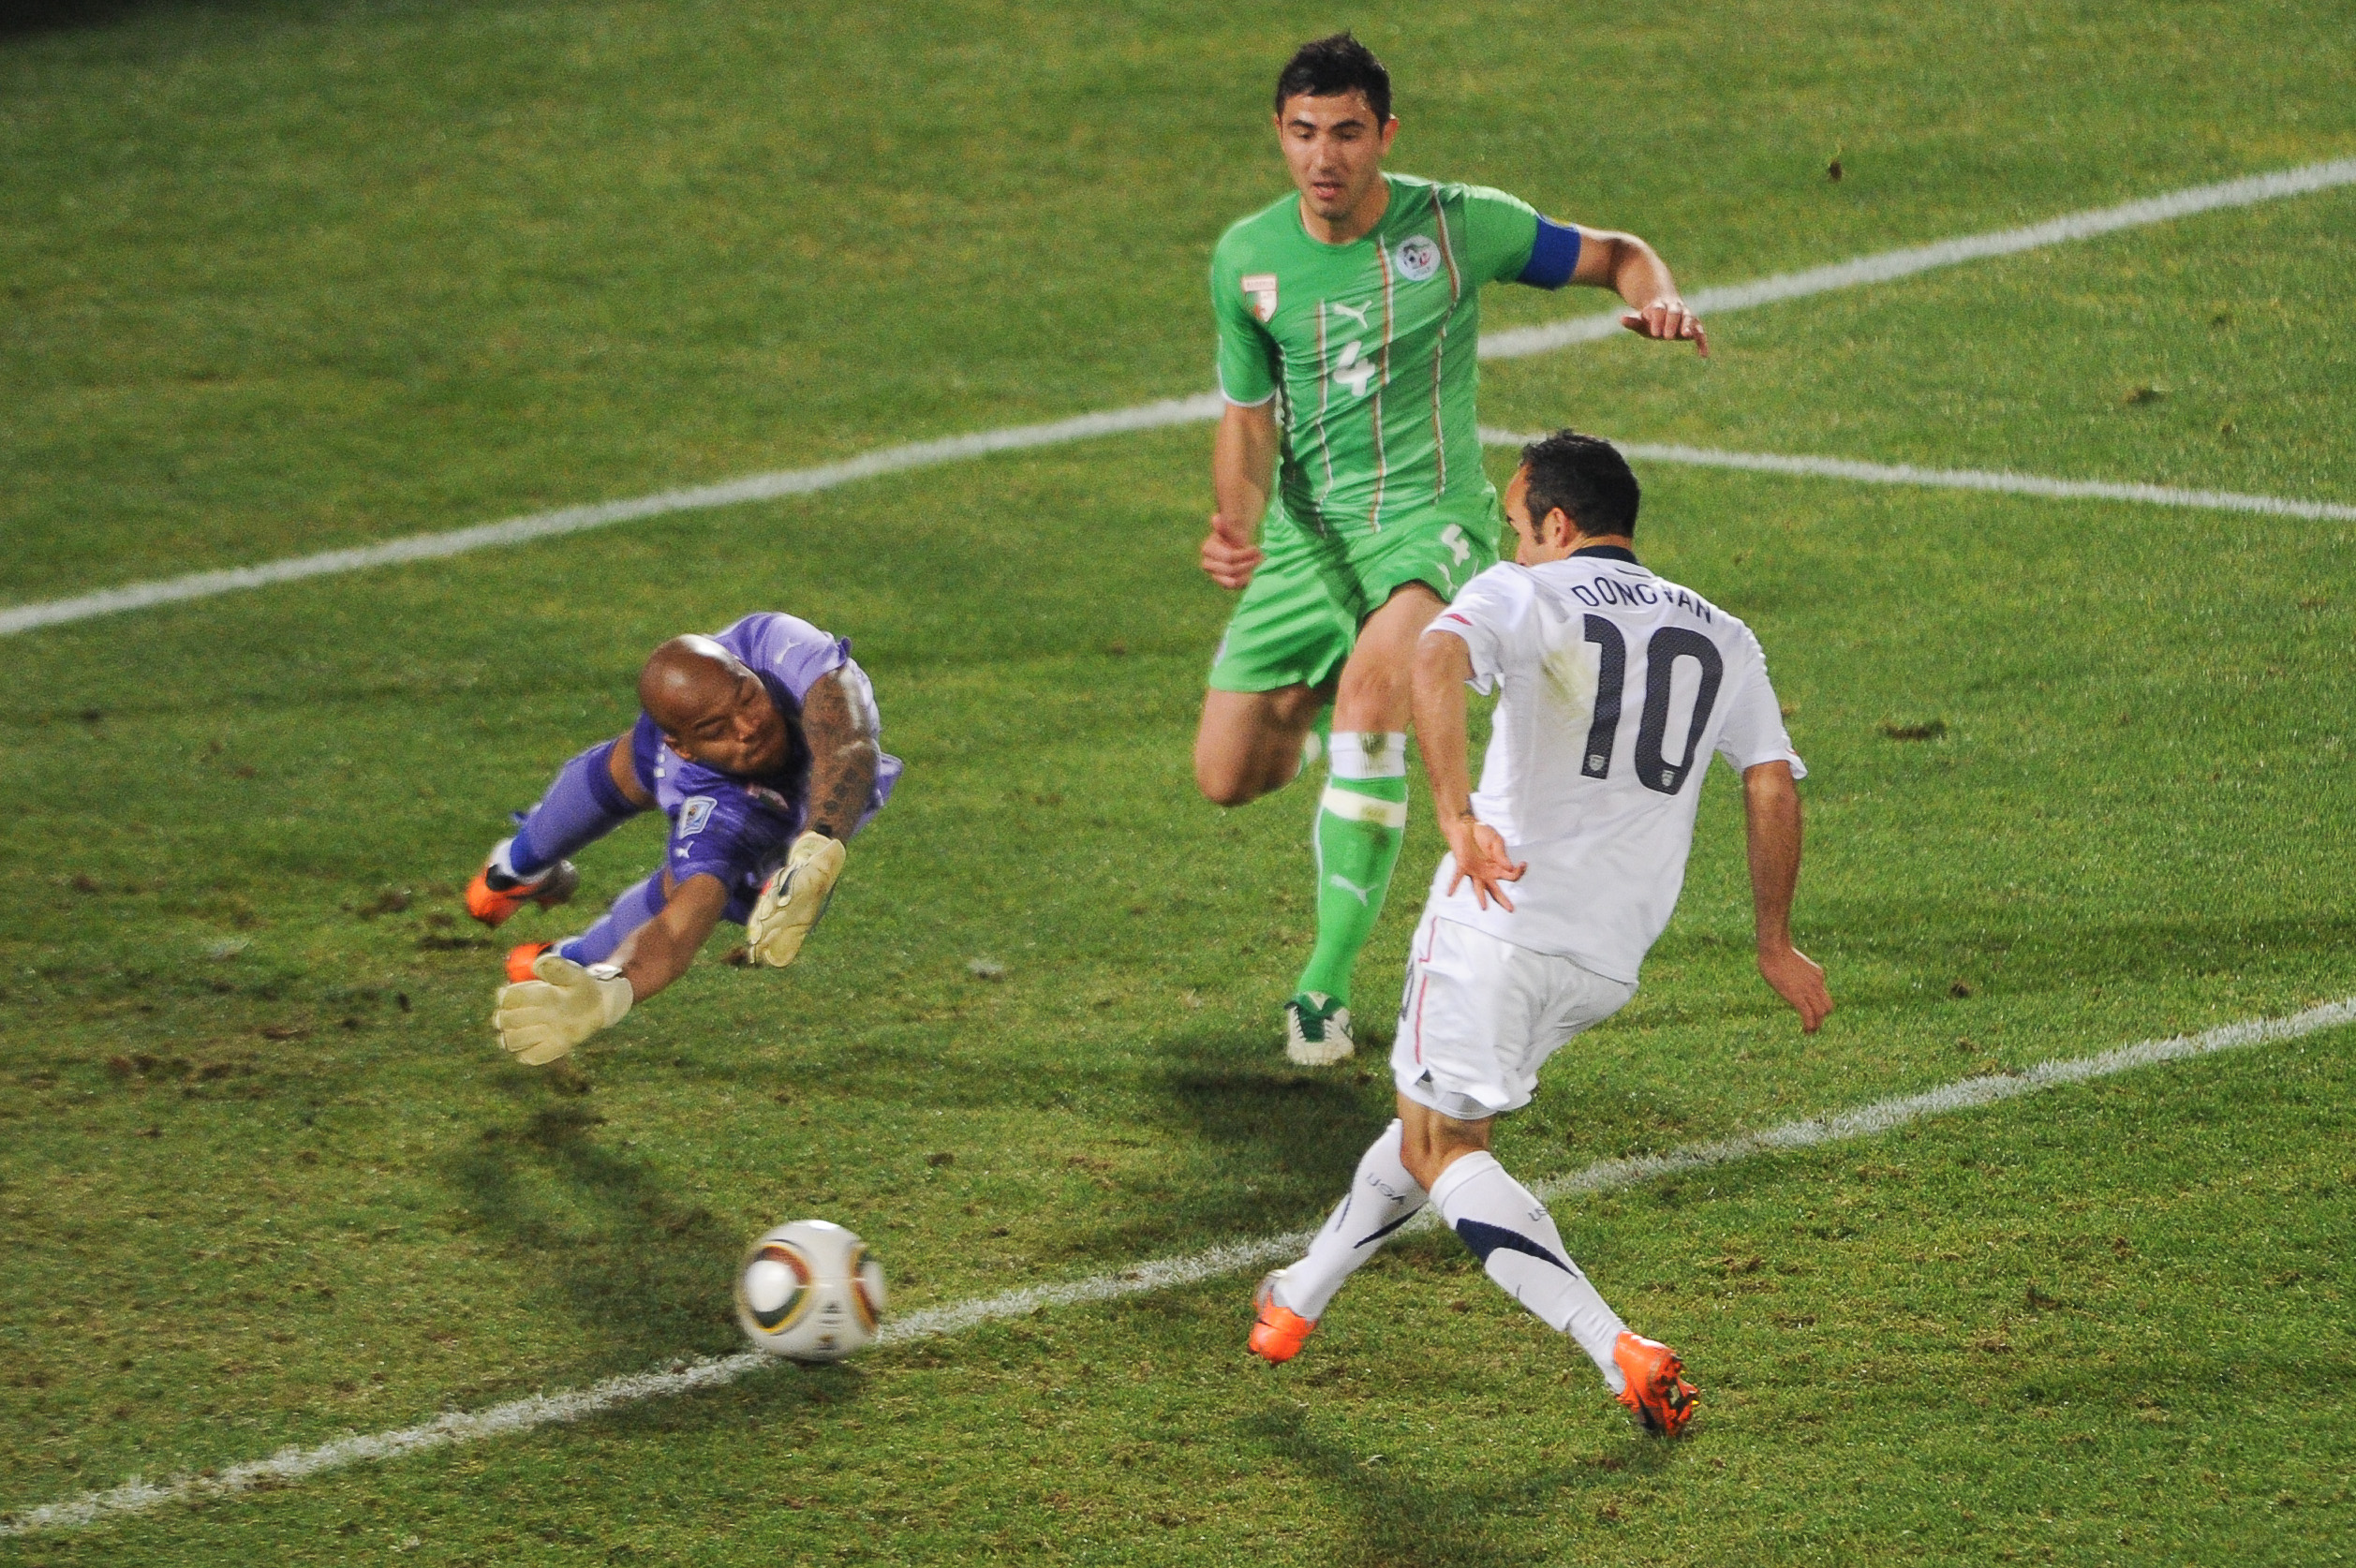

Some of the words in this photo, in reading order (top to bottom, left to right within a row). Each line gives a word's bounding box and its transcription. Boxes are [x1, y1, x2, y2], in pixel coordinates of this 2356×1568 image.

[1333, 341, 1376, 397] 4
[1441, 523, 1471, 568] 4
[1570, 576, 1712, 625] DONOVAN
[1579, 613, 1724, 796] 10
